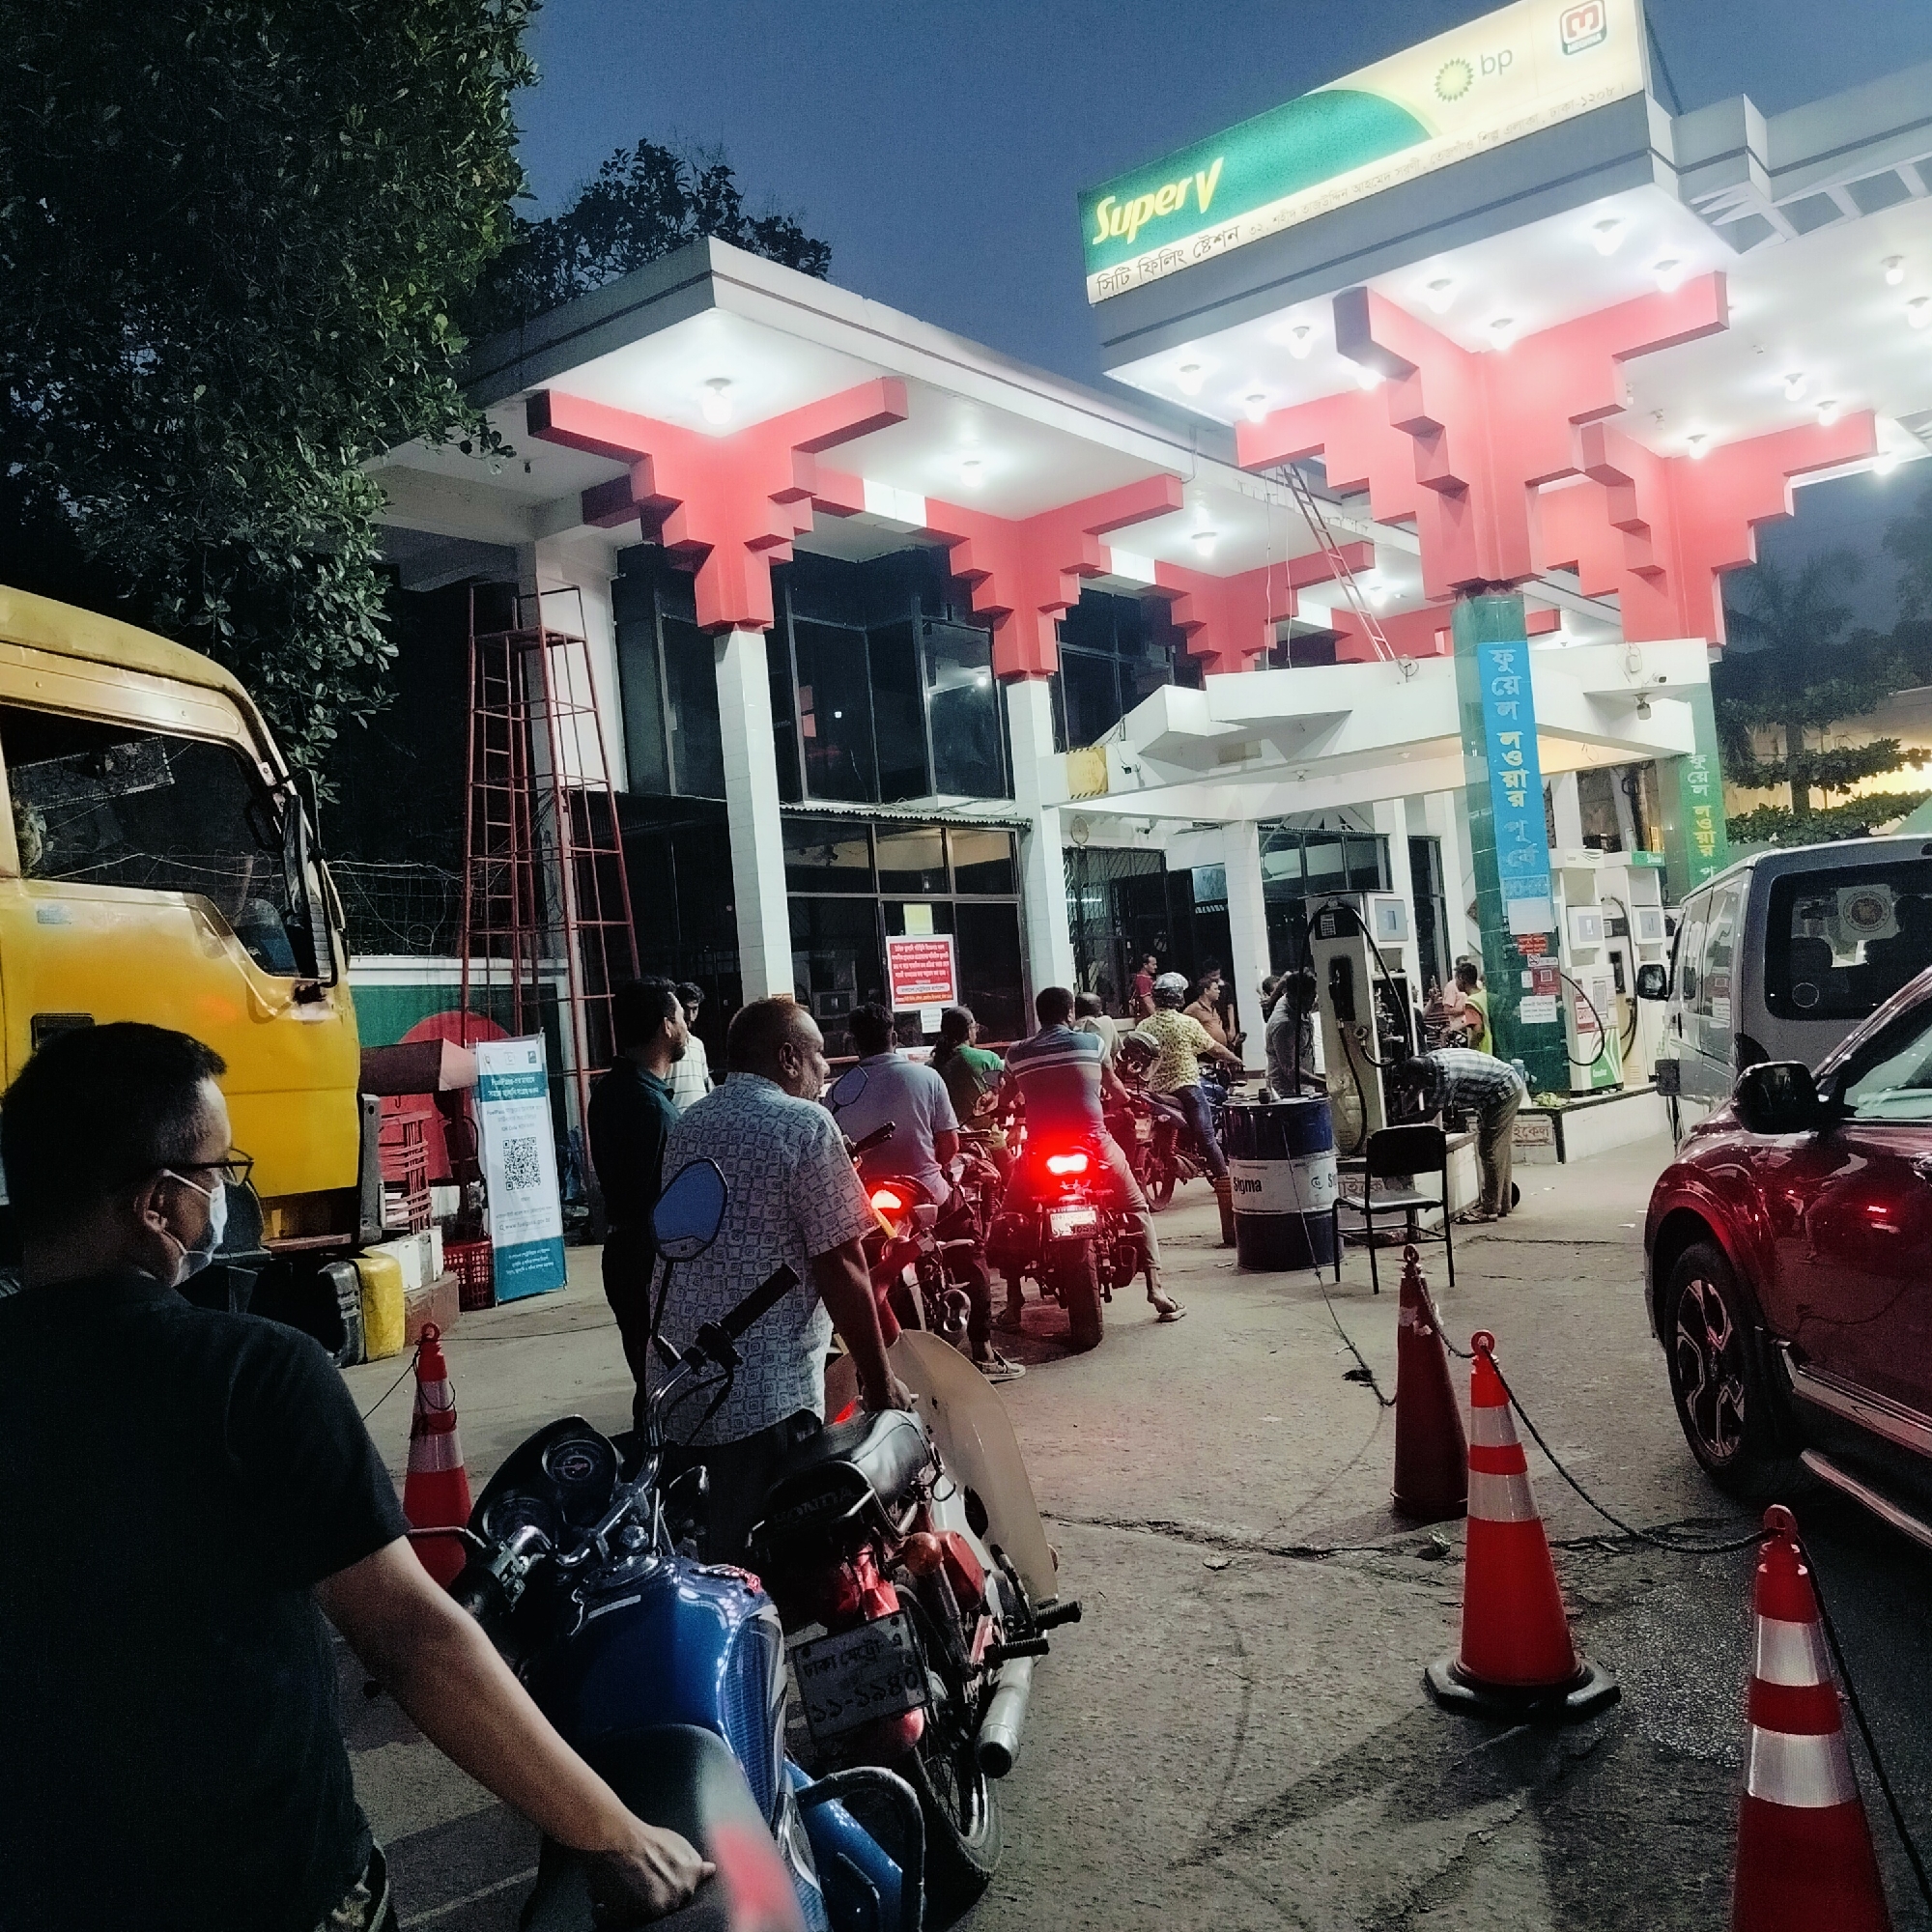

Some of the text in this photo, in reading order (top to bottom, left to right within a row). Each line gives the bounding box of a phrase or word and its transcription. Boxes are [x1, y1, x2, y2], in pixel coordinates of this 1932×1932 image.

[1480, 49, 1513, 76] bp
[1093, 176, 1194, 245] Super
[1096, 266, 1132, 297] সিটি
[1137, 248, 1188, 281] ফিলিং
[1233, 1177, 1263, 1195] Sigma
